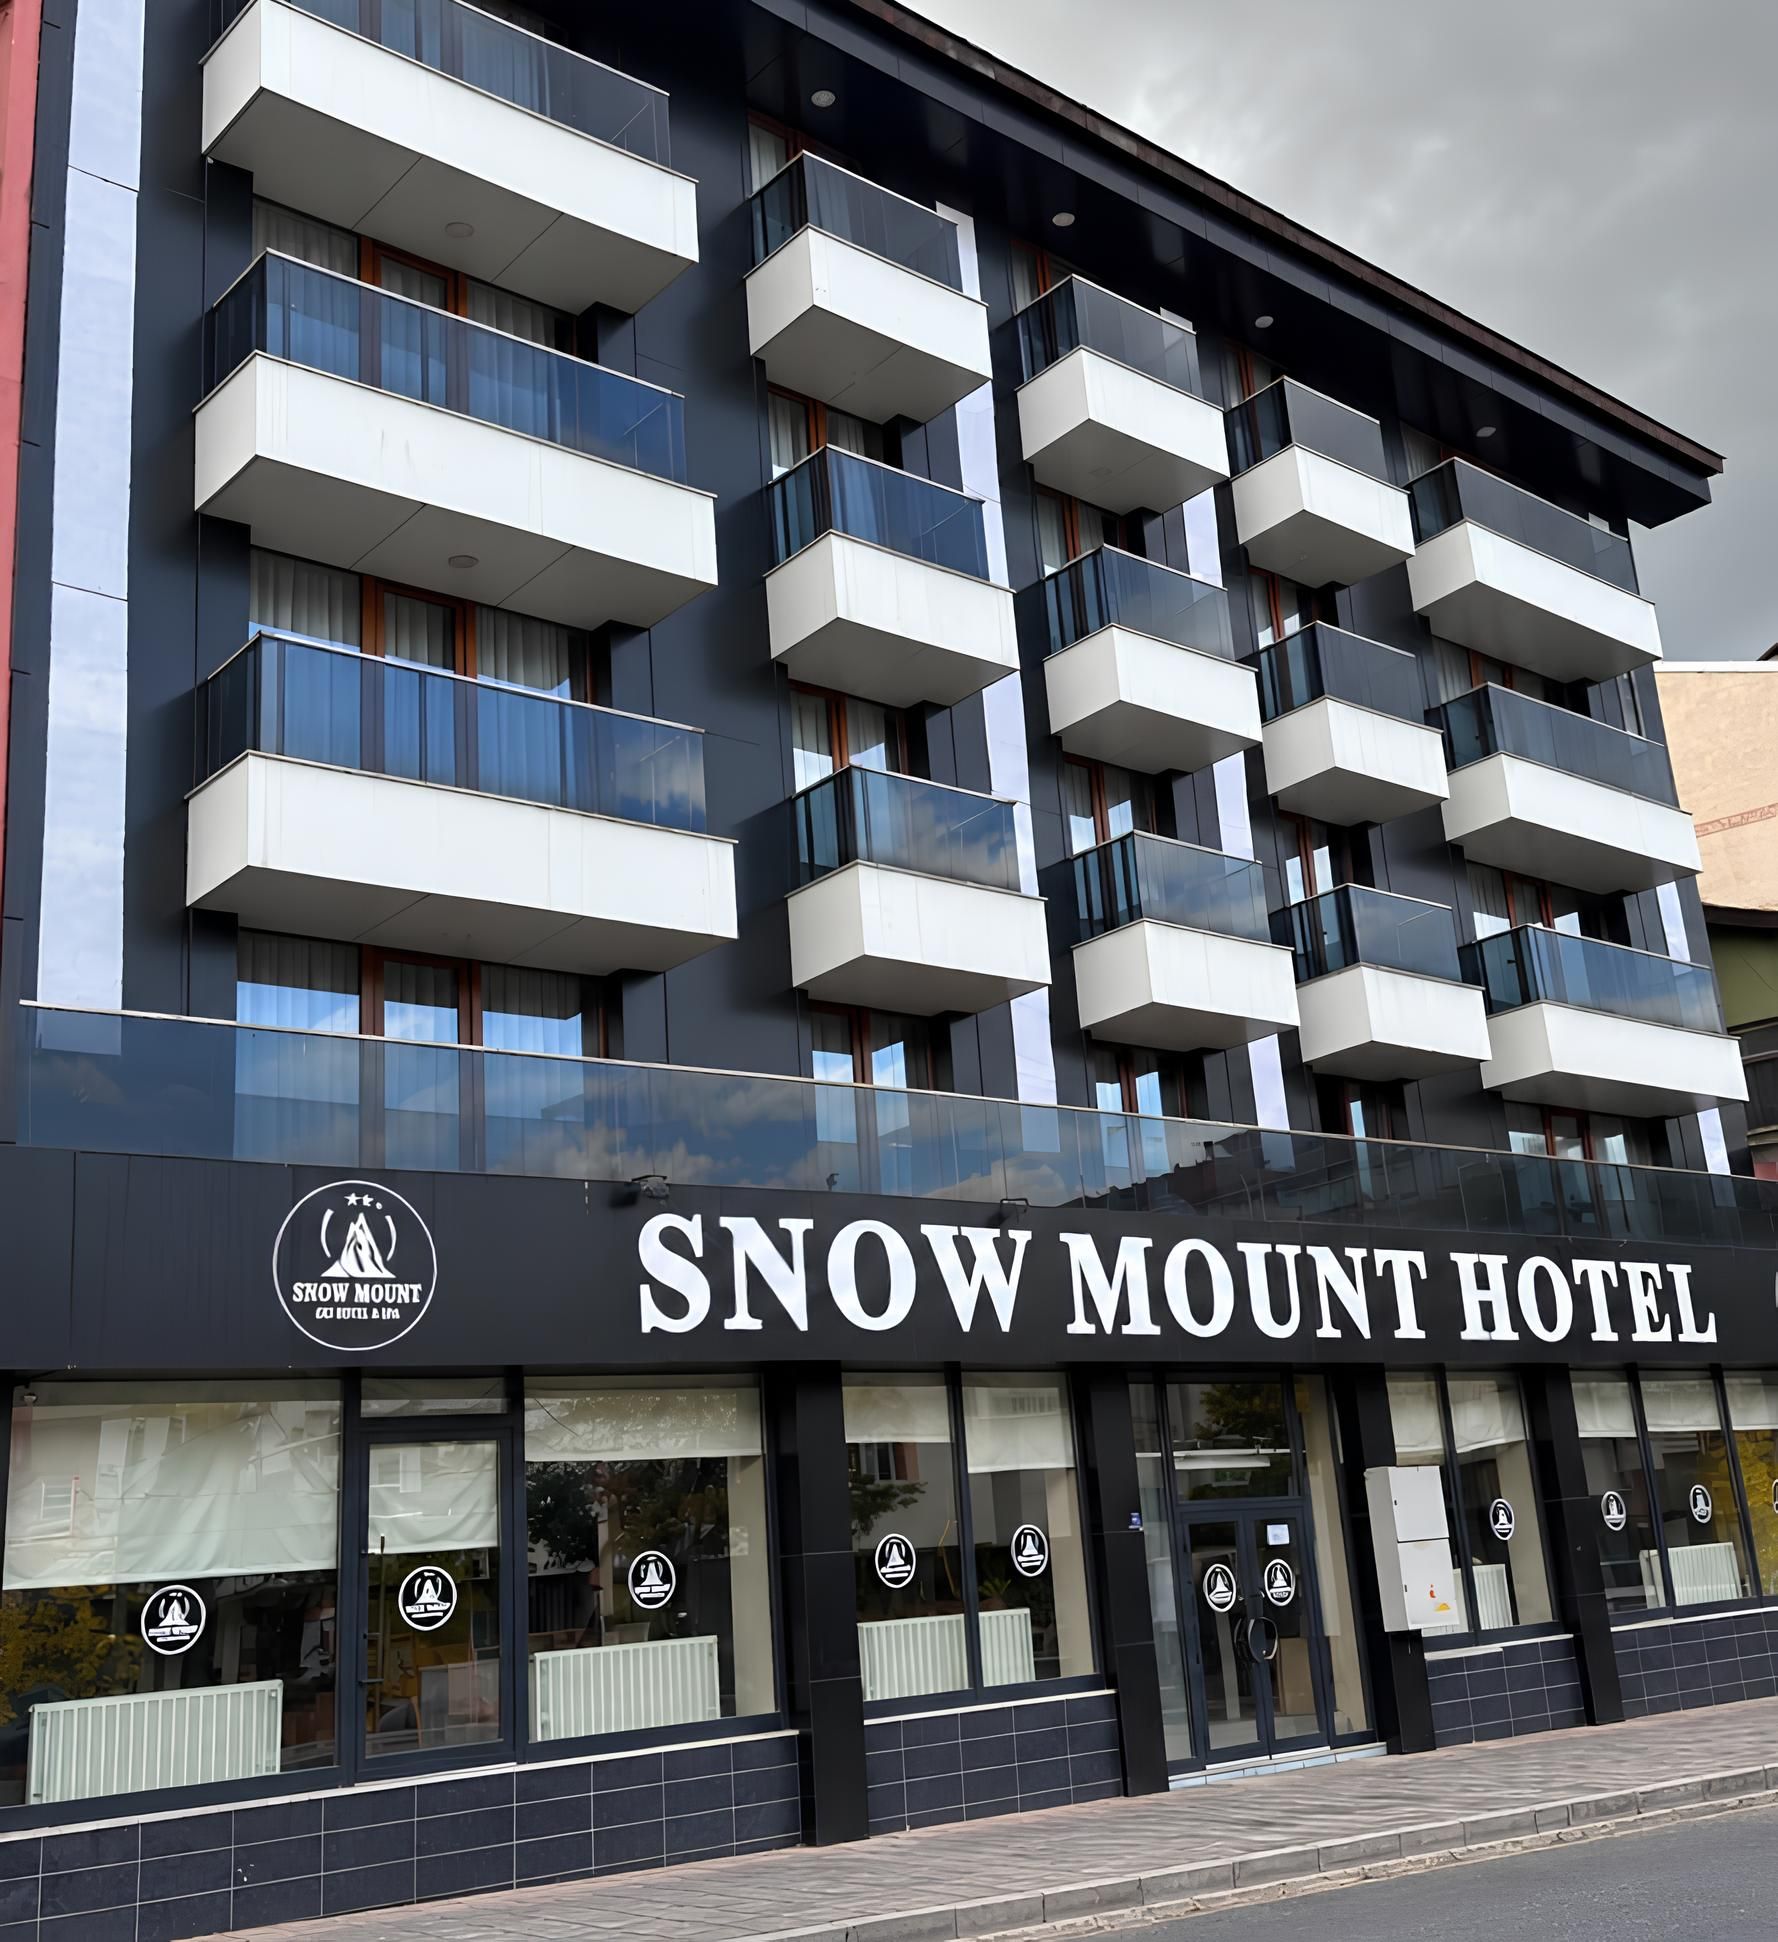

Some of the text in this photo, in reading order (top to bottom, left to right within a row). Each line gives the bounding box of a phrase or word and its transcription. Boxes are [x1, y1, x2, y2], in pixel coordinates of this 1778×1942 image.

[354, 1283, 422, 1303] MOUNT
[638, 1212, 1718, 1343] SNOW MOUNT HOTEL
